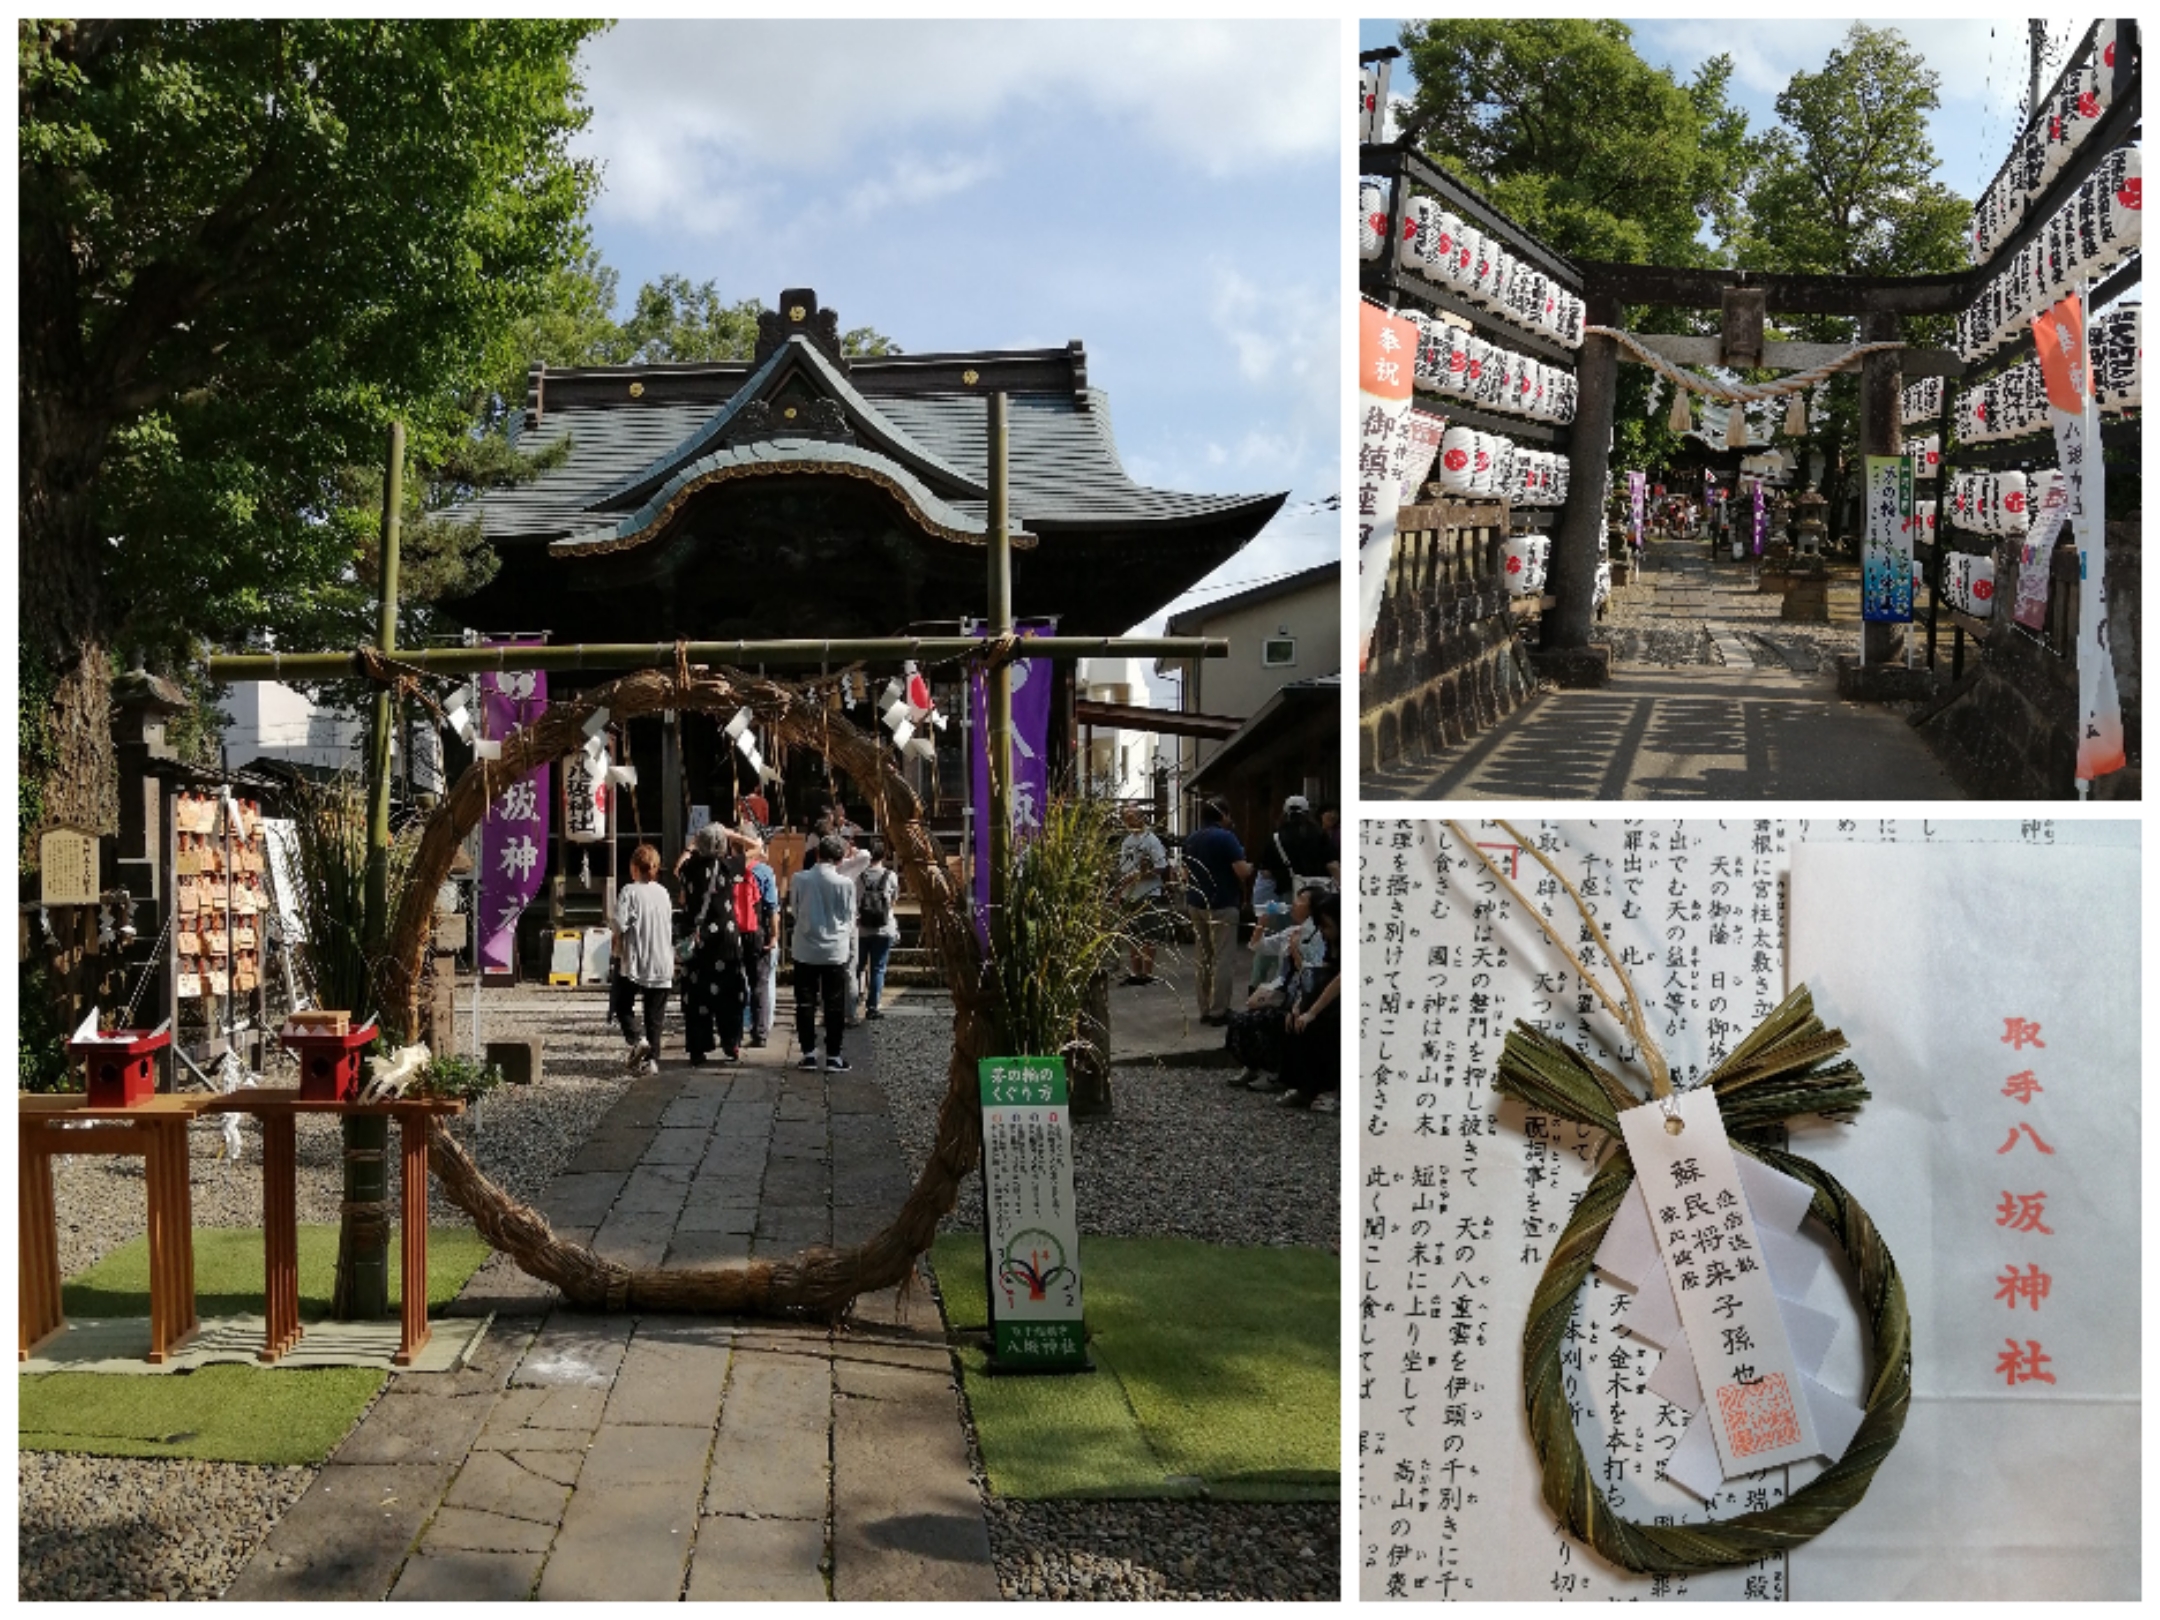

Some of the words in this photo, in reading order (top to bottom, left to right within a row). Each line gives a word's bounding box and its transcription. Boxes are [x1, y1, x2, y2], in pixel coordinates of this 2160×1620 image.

[1375, 327, 1402, 387] 奉祝
[1359, 405, 1397, 576] 御鎮座
[566, 752, 597, 834] 八坂神社
[992, 1084, 1053, 1102] くぐり方
[1994, 1016, 2057, 1387] 取手八坂神社
[1066, 1294, 1074, 1307] 2
[1670, 1157, 1764, 1385] 蘇民将来子孫也
